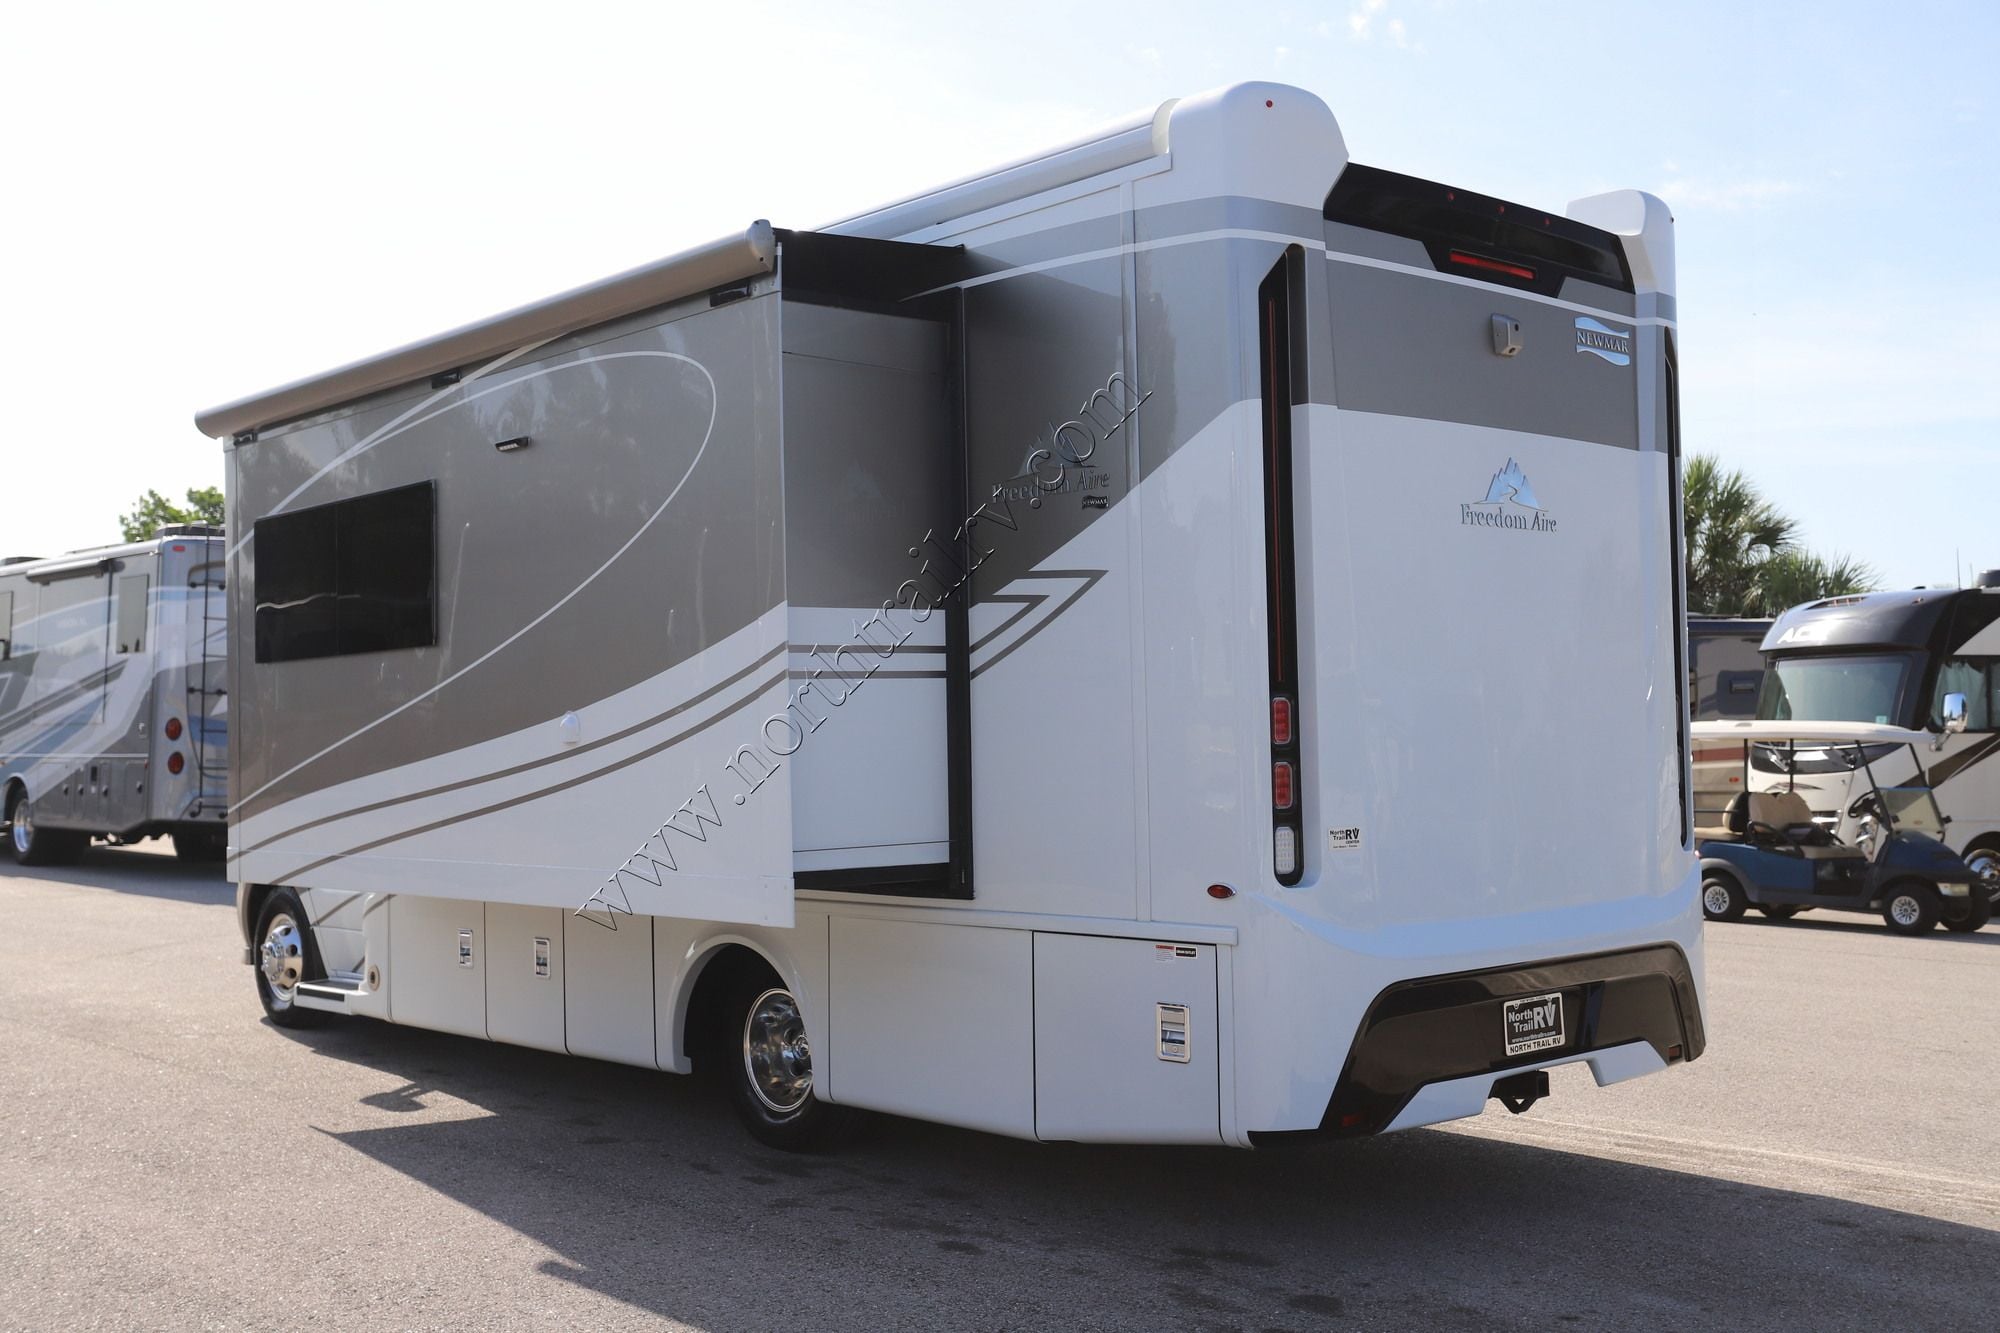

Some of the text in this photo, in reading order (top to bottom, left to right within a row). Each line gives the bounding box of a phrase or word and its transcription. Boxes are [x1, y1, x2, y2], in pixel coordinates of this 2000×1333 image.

[1576, 330, 1629, 353] NEWMAR
[1075, 469, 1110, 492] Aire
[1460, 503, 1557, 533] Freedom Aire
[1345, 828, 1360, 840] RV
[1508, 1009, 1533, 1023] North
[1533, 1003, 1556, 1029] RV
[1513, 1020, 1534, 1033] Trail
[1510, 1036, 1561, 1054] NORTH TRAIL RV
